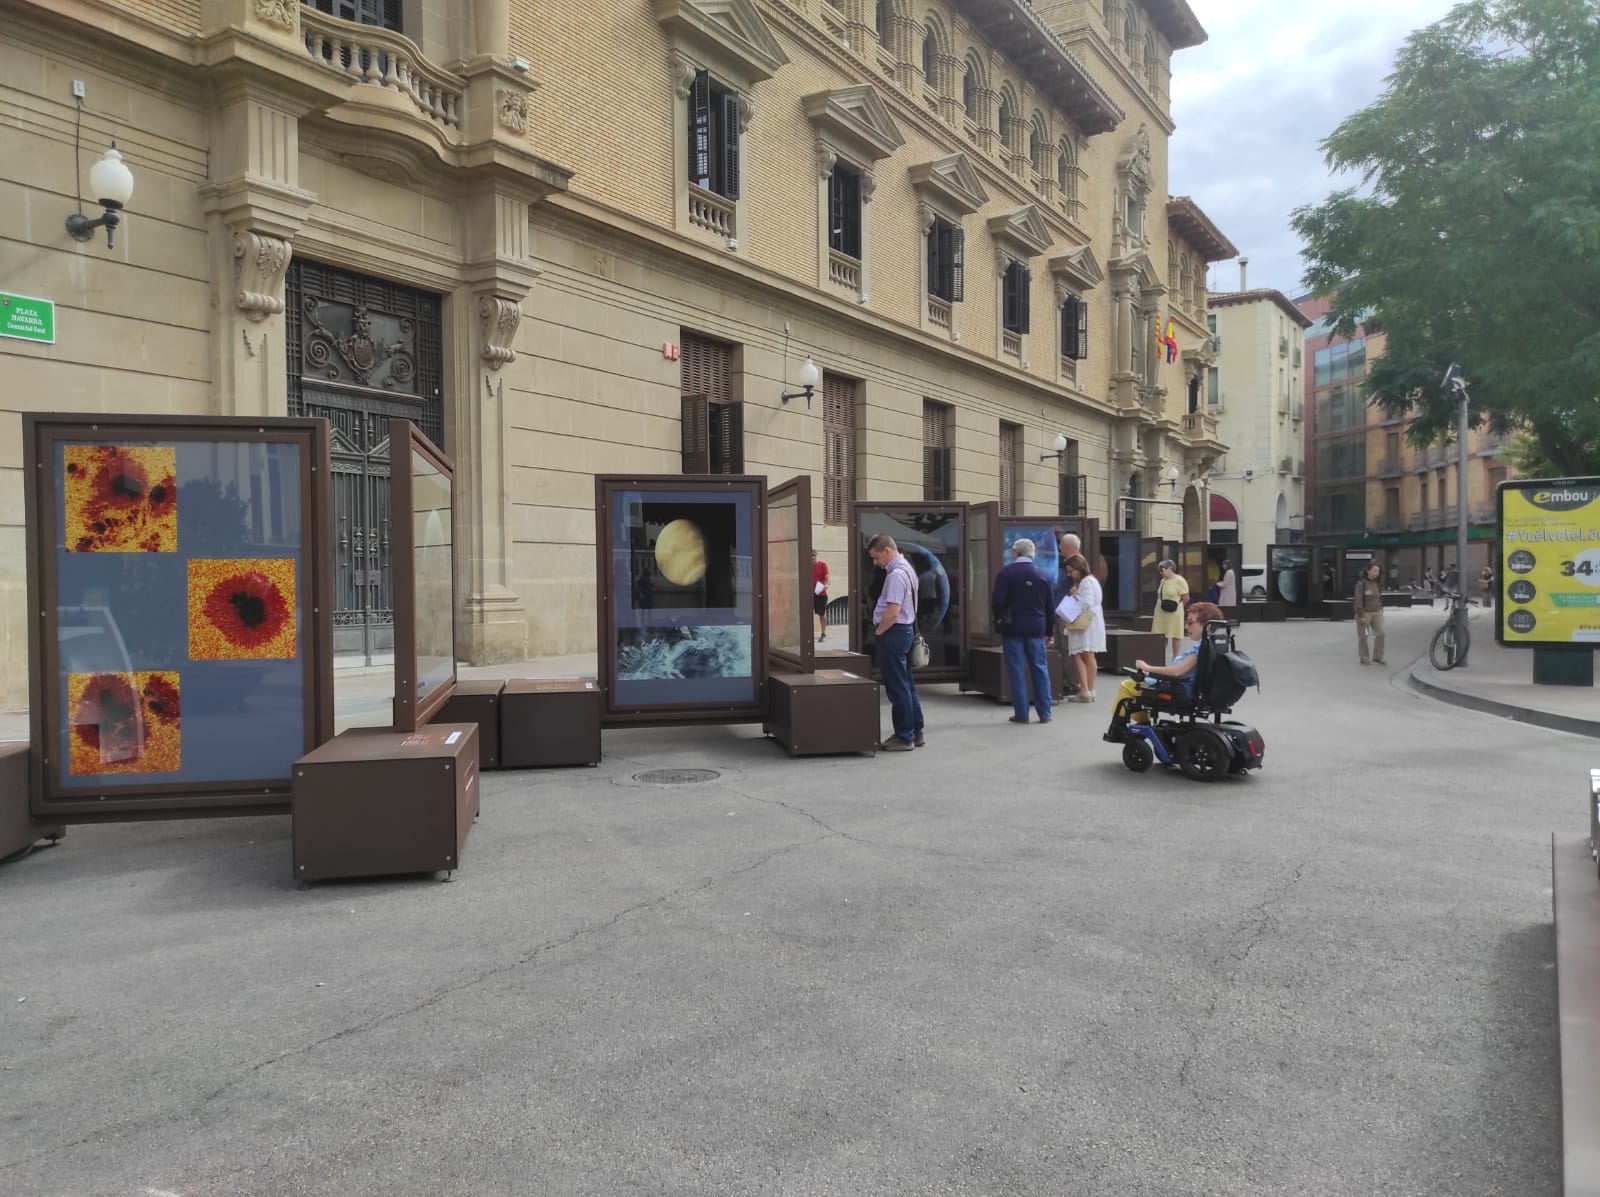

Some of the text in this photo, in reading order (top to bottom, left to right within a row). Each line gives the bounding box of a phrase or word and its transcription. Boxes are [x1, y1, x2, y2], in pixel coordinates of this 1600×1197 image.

[16, 307, 38, 317] PLAZA
[11, 314, 43, 326] NAVARRA
[1533, 490, 1588, 504] embou
